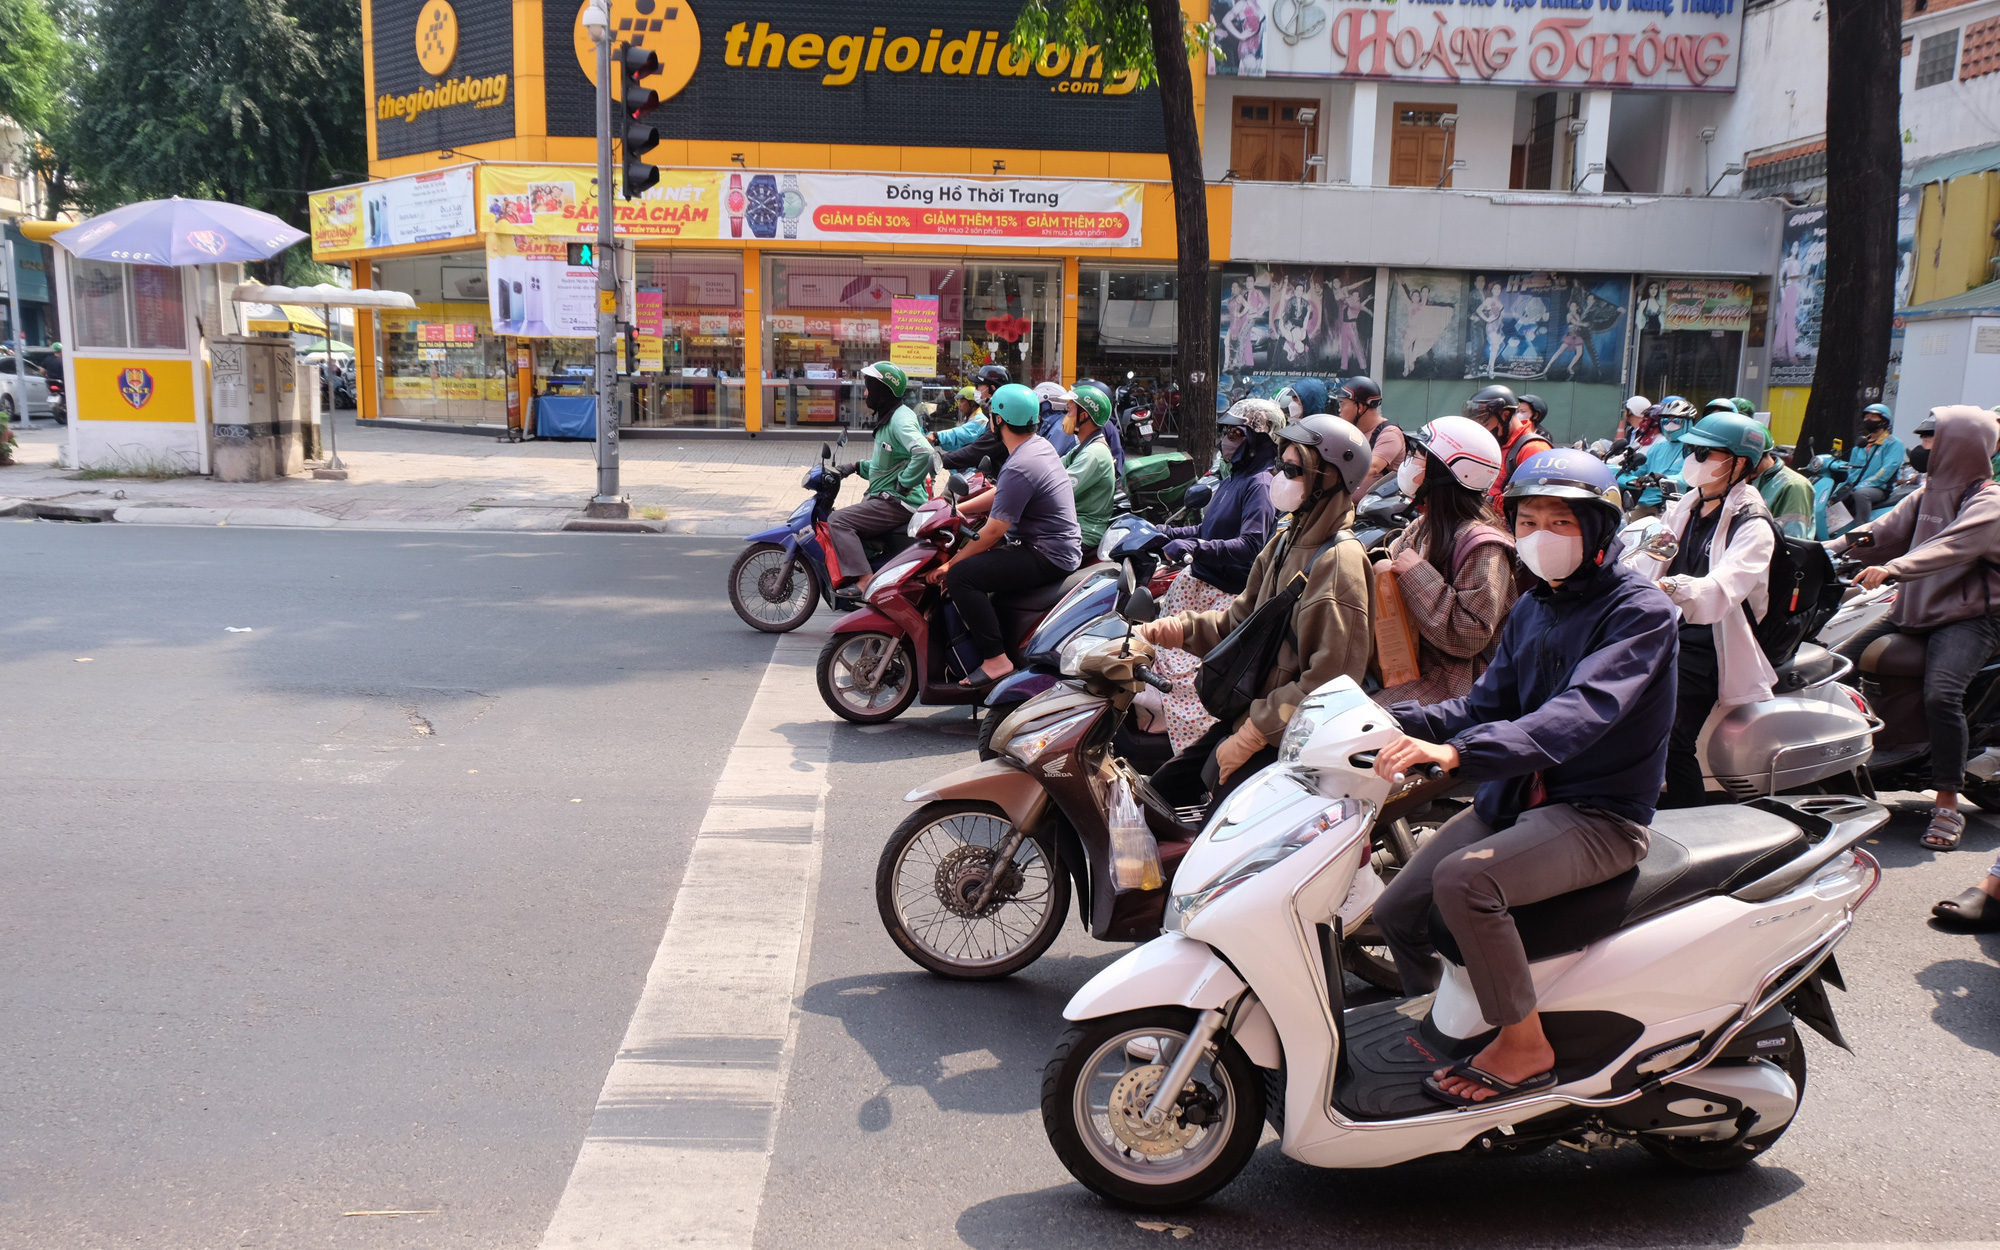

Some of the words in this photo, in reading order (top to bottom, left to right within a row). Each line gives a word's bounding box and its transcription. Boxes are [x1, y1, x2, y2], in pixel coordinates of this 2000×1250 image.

[1332, 9, 1518, 79] HOÀNG
[1529, 17, 1730, 86] THÔNG
[378, 74, 508, 122] thegioididong
[664, 184, 706, 202] NÉT
[886, 185, 934, 204] Đồng
[940, 186, 963, 202] Hồ
[967, 187, 1005, 203] Thời
[1009, 188, 1059, 207] Trang
[613, 202, 648, 221] TRẢ
[650, 204, 709, 226] CHẬM
[820, 211, 853, 225] GIẢM
[857, 211, 882, 226] ĐẾN
[885, 215, 912, 227] 30%
[923, 211, 956, 225] GIẢM
[959, 212, 991, 226] THÊM
[994, 215, 1017, 227] 15%
[1026, 213, 1059, 228] GIẢM
[1062, 214, 1095, 228] THÊM
[1098, 217, 1123, 228] 20%
[661, 225, 677, 233] SAU
[971, 226, 983, 234] sản
[984, 226, 1003, 235] phẩm
[1087, 229, 1107, 238] phẩm
[884, 372, 900, 387] Grab
[1190, 373, 1205, 383] 57
[1865, 387, 1880, 398] 59
[1084, 395, 1100, 412] Grab
[1533, 457, 1569, 470] IJC
[877, 596, 895, 605] HONDA
